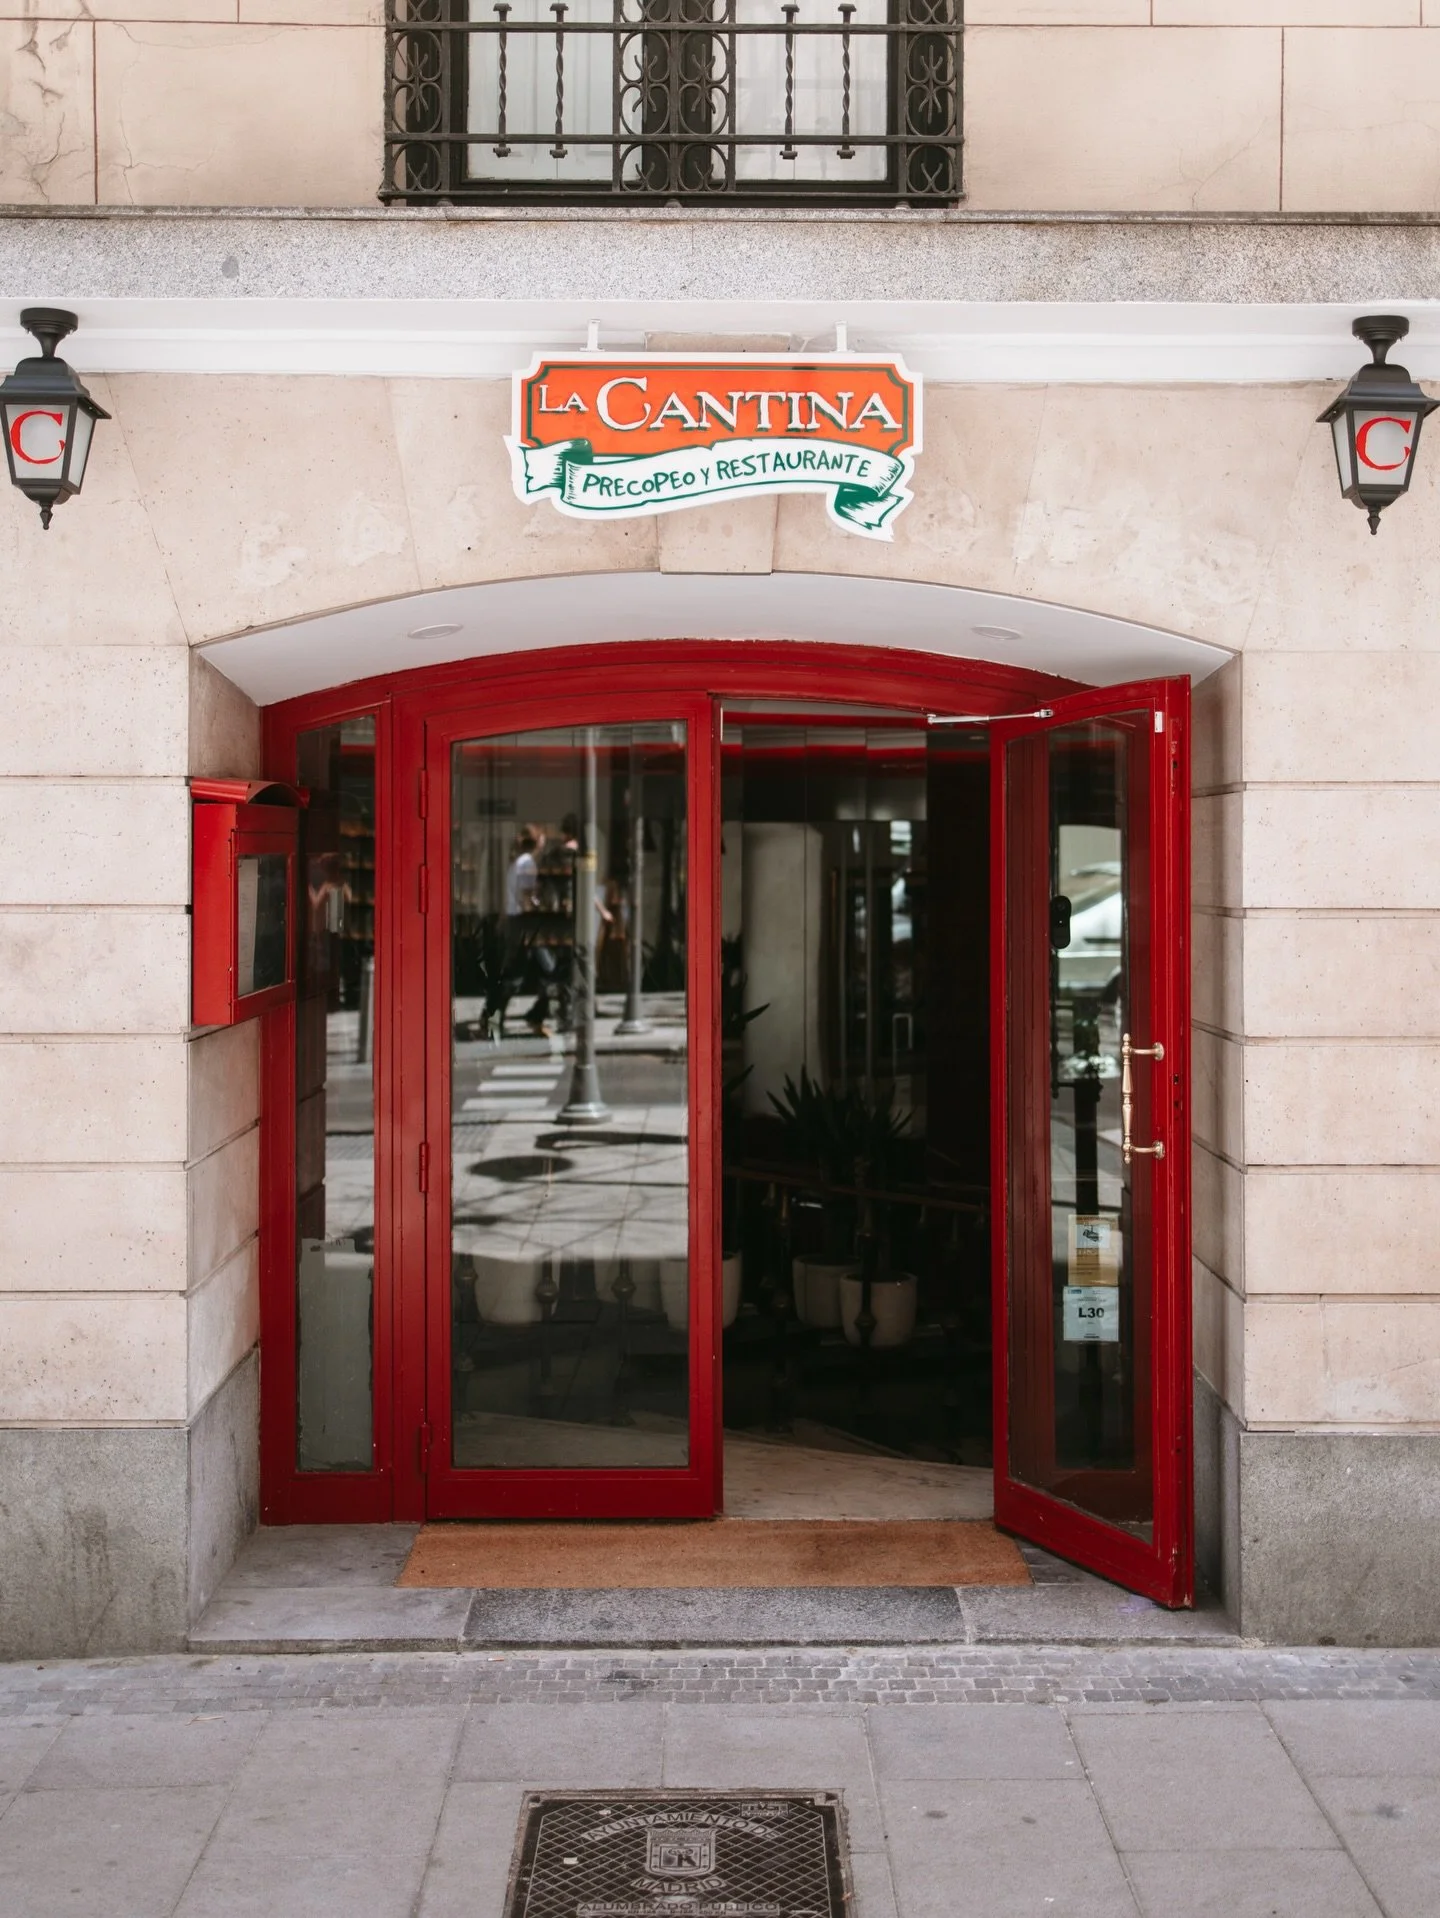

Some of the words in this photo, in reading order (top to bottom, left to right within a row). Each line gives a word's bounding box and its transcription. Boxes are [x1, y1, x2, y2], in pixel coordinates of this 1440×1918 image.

[539, 384, 588, 412] LA
[597, 377, 903, 432] CANTINA
[11, 410, 65, 465] C
[1356, 417, 1412, 470] C
[582, 471, 694, 497] PRECOPEO
[700, 468, 710, 485] Y
[716, 451, 872, 479] RESTAURANTE
[1078, 1307, 1105, 1318] L30
[589, 1812, 750, 1841] AYUNTAMIENTO
[633, 1878, 723, 1893] MADRID
[580, 1901, 694, 1912] ALUMBRADO
